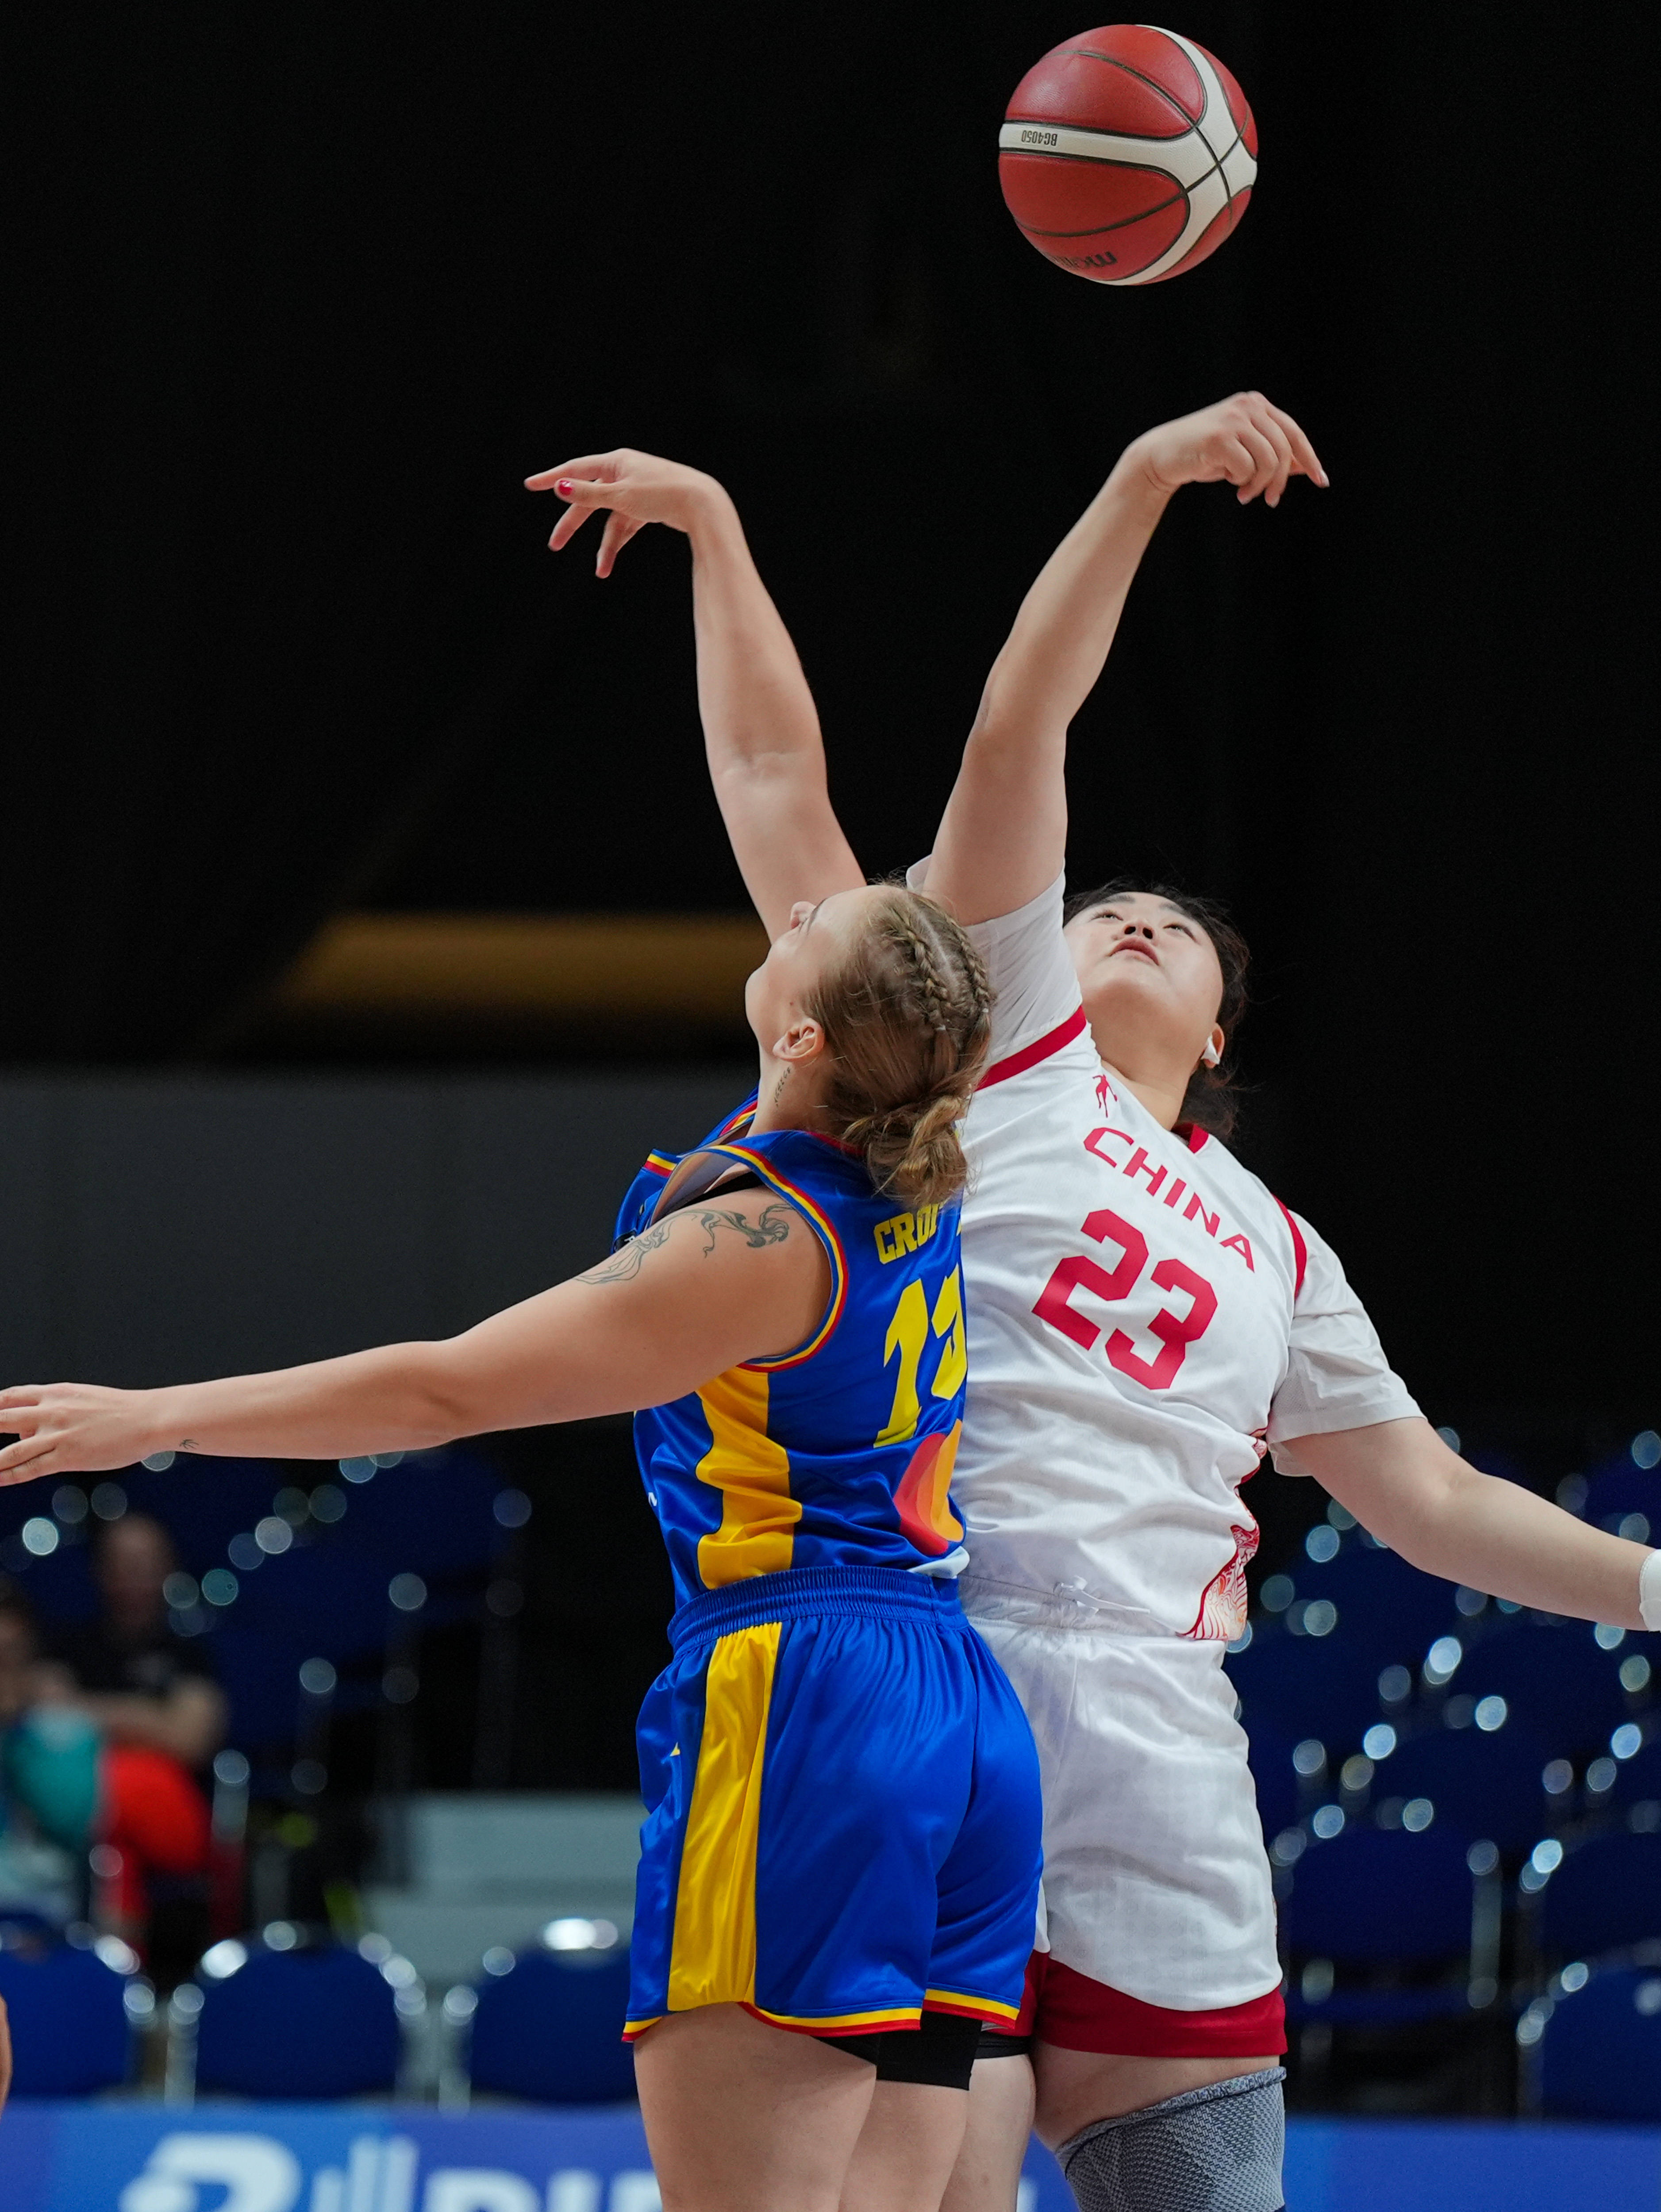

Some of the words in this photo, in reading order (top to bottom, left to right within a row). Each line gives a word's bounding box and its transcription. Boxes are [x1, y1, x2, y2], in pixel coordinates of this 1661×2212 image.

[1021, 130, 1057, 146] BG4050
[1083, 1127, 1255, 1273] CHINA
[1031, 1209, 1218, 1390] 23
